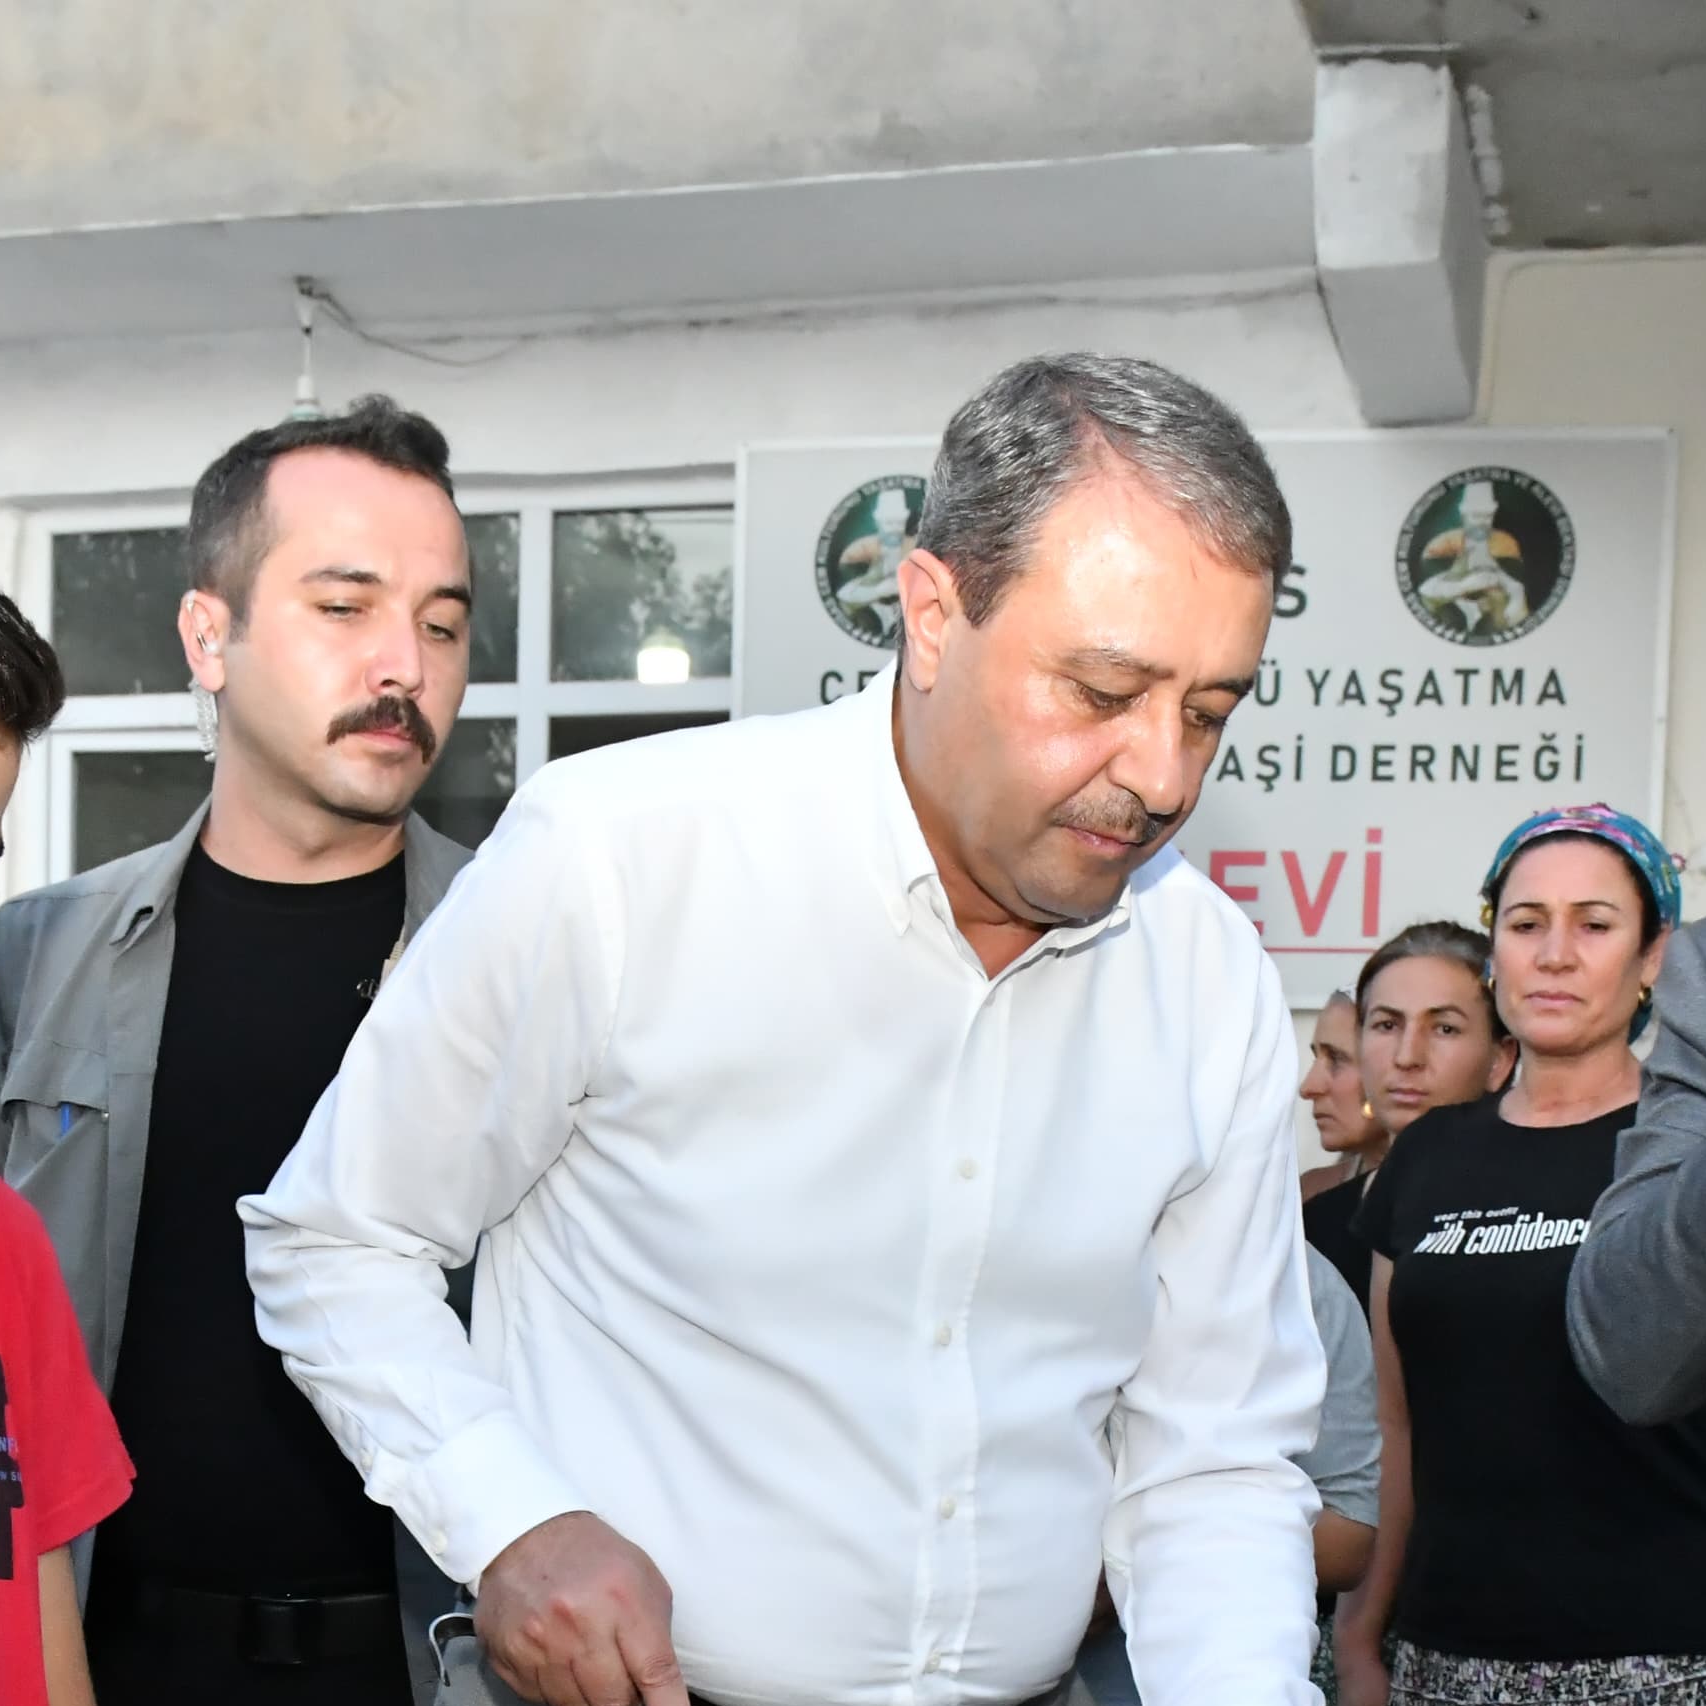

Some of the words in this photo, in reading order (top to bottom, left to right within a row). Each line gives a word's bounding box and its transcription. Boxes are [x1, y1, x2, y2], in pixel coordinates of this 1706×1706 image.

[1306, 668, 1567, 718] YAŞATMA
[1216, 733, 1304, 792] AŞİ
[1330, 733, 1585, 783] DERNEĞİ
[1209, 827, 1383, 938] EVİ
[1413, 1220, 1467, 1255] with
